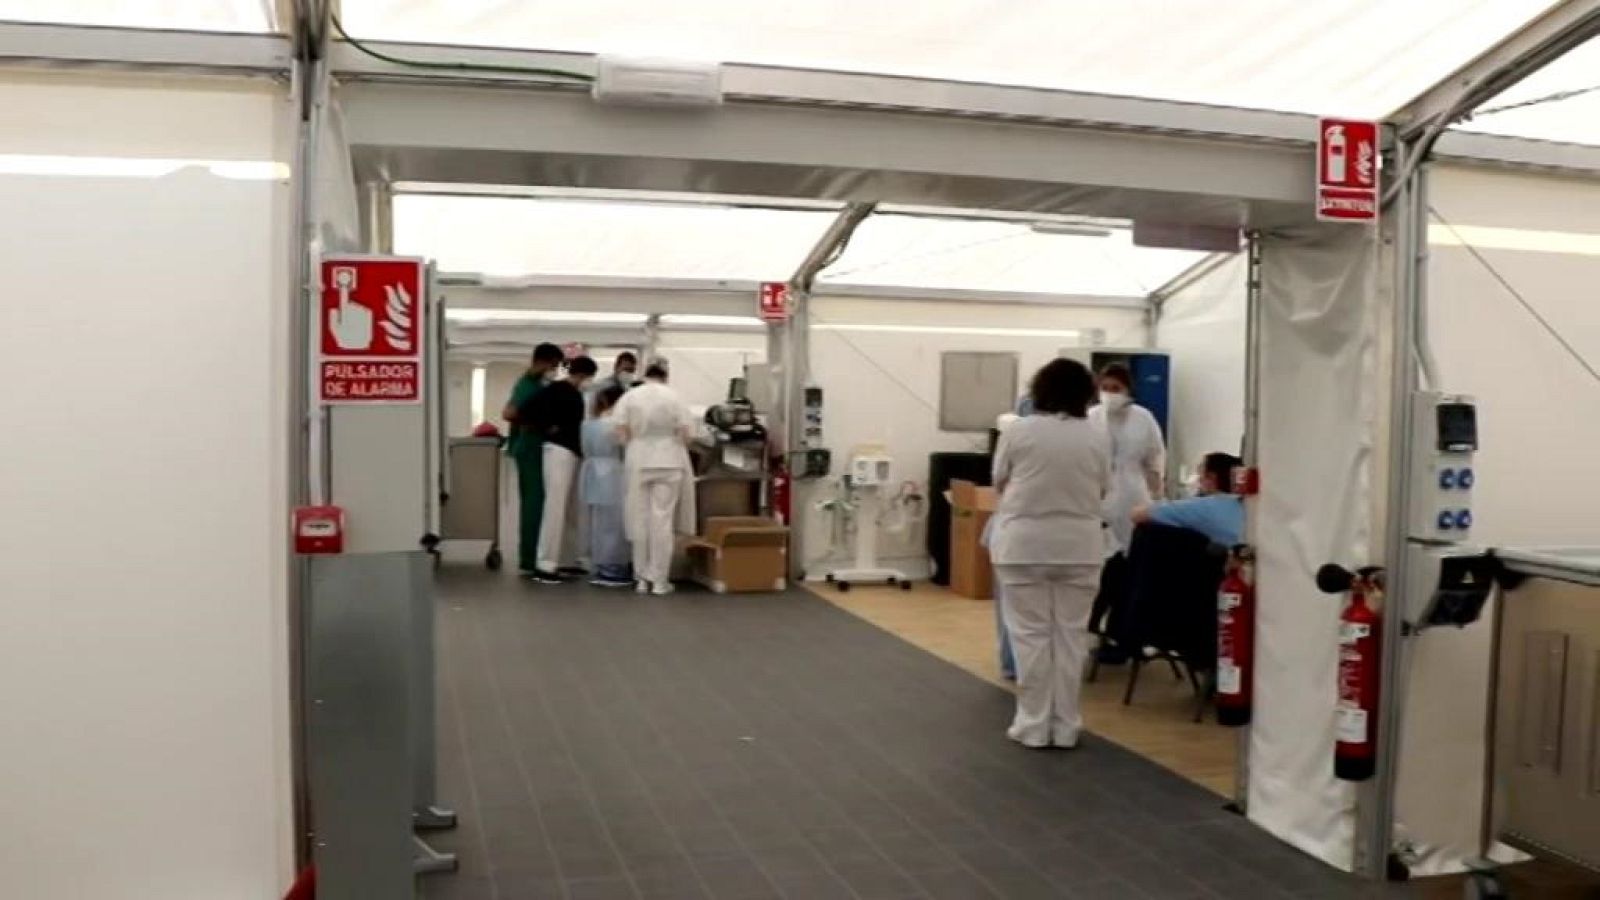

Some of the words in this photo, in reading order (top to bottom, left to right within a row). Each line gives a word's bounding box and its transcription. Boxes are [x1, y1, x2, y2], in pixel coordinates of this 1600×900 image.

[325, 365, 413, 378] PULSADOR
[325, 382, 346, 395] DE
[350, 382, 412, 395] ALARMA
